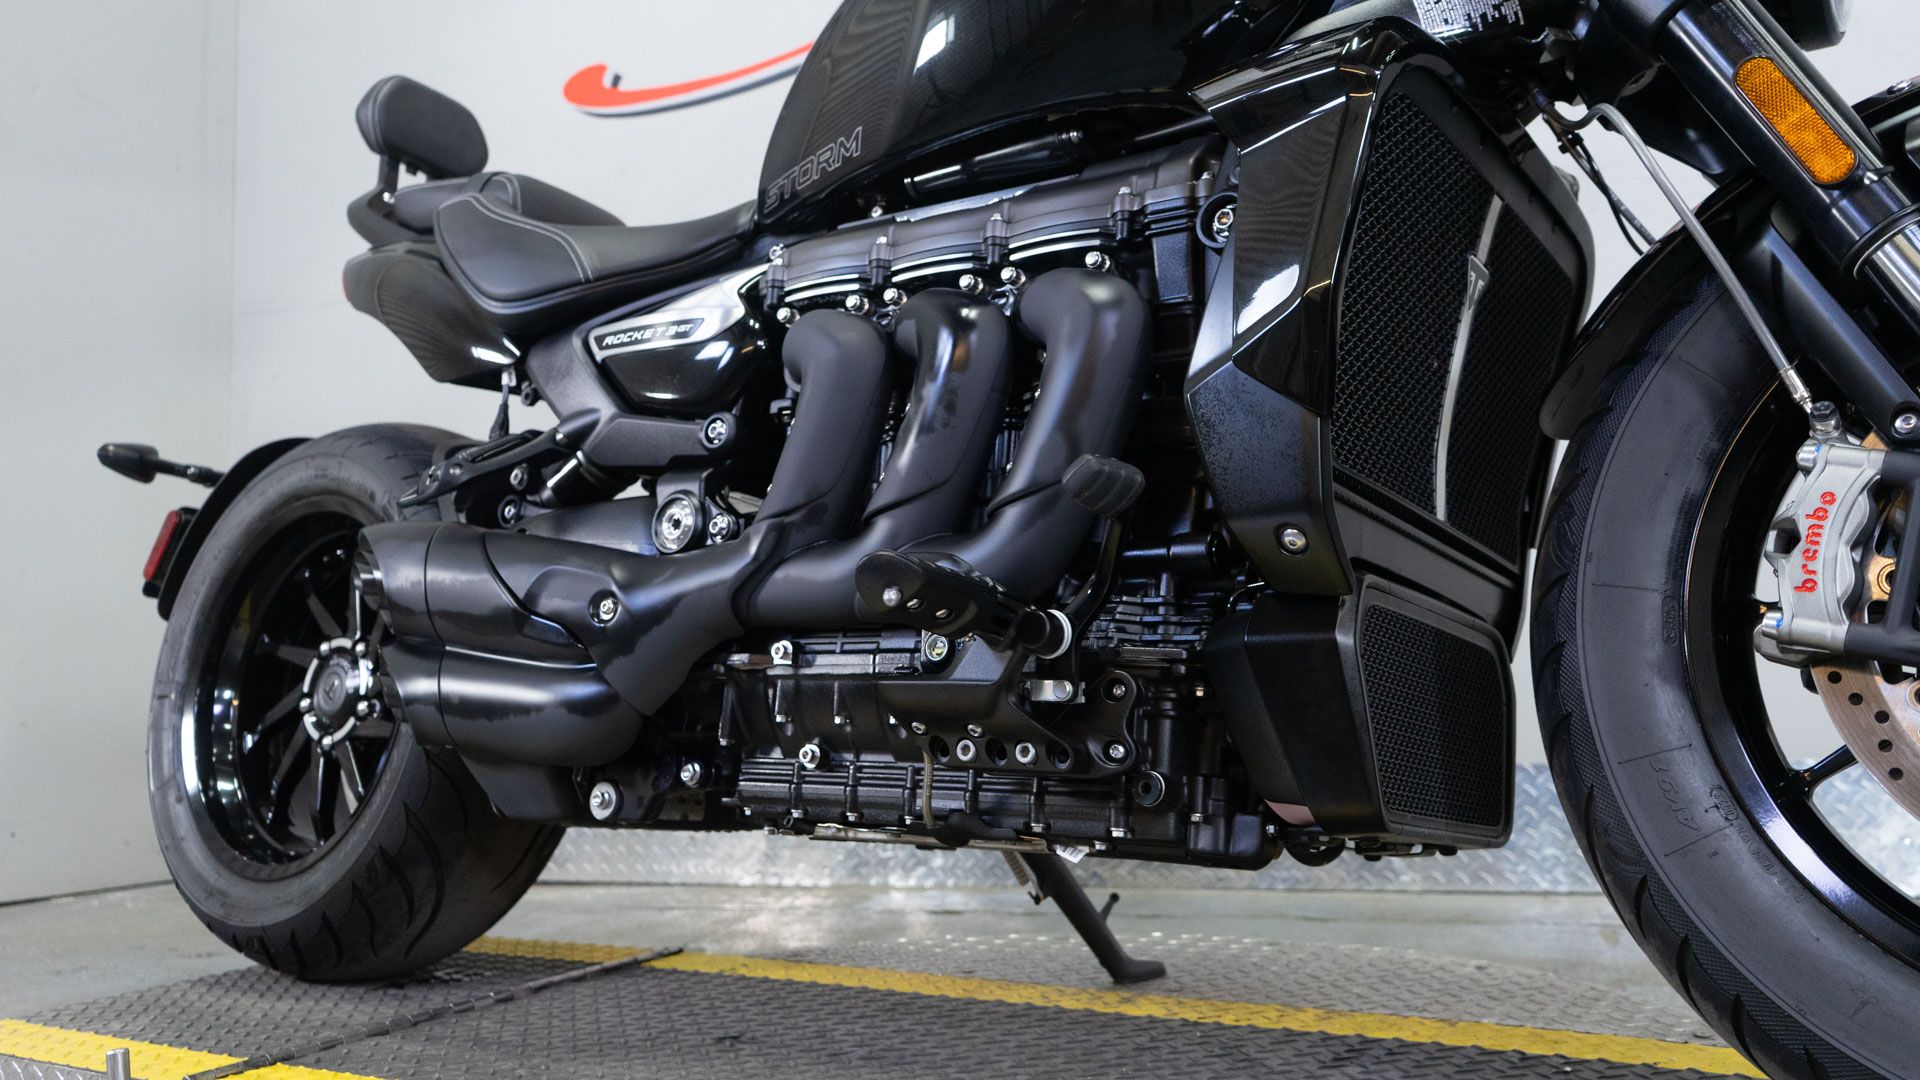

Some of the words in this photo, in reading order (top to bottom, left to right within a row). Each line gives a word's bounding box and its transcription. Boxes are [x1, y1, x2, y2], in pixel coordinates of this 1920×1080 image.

[763, 125, 863, 215] STORM
[602, 327, 668, 347] ROCKET
[1793, 491, 1837, 593] brembo
